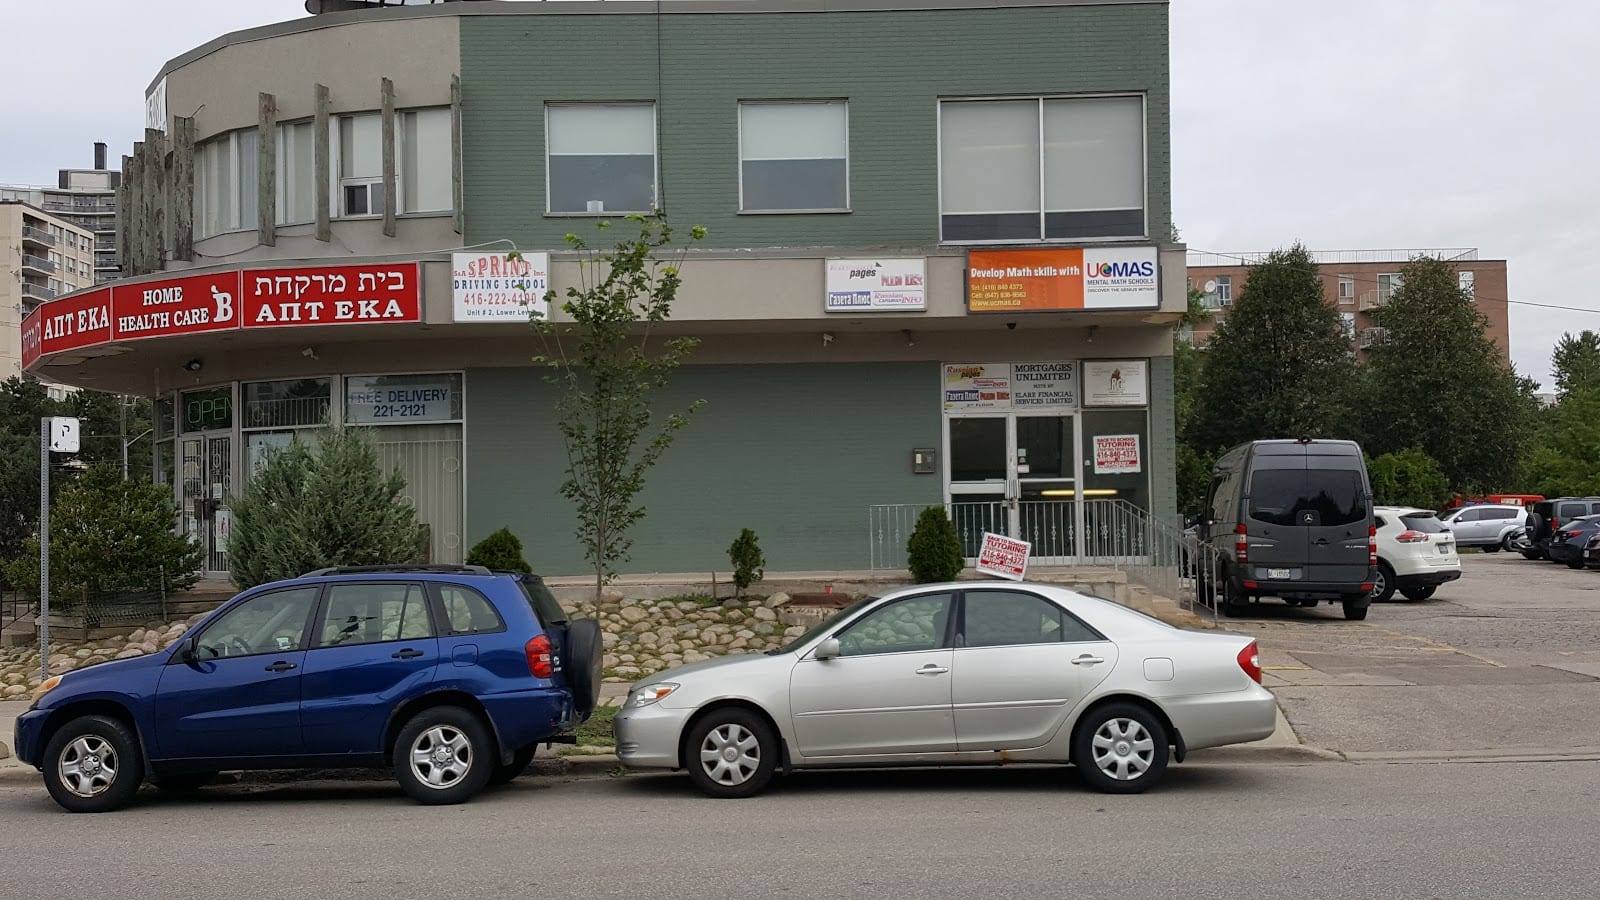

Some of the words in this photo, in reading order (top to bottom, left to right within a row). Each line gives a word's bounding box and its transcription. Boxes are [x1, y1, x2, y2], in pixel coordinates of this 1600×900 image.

[468, 256, 532, 278] SPRINT
[970, 268, 1004, 279] Develop
[1006, 267, 1032, 277] Math
[1034, 266, 1058, 276] skills
[1059, 266, 1080, 276] with
[1087, 261, 1154, 278] UCMAS
[849, 269, 877, 279] pages
[254, 274, 346, 300] מרקחת
[358, 272, 404, 292] בית
[454, 280, 499, 289] DRIVING
[505, 280, 545, 289] SCHOOL
[142, 286, 183, 306] HOME
[118, 312, 170, 332] HEALTH
[174, 308, 209, 326] CARE
[1015, 364, 1072, 372] MORTGAGES
[1016, 373, 1071, 381] UNLIMITED
[388, 389, 448, 402] DELIVERY
[373, 404, 425, 417] 221-2121
[987, 540, 1026, 554] TUTORING
